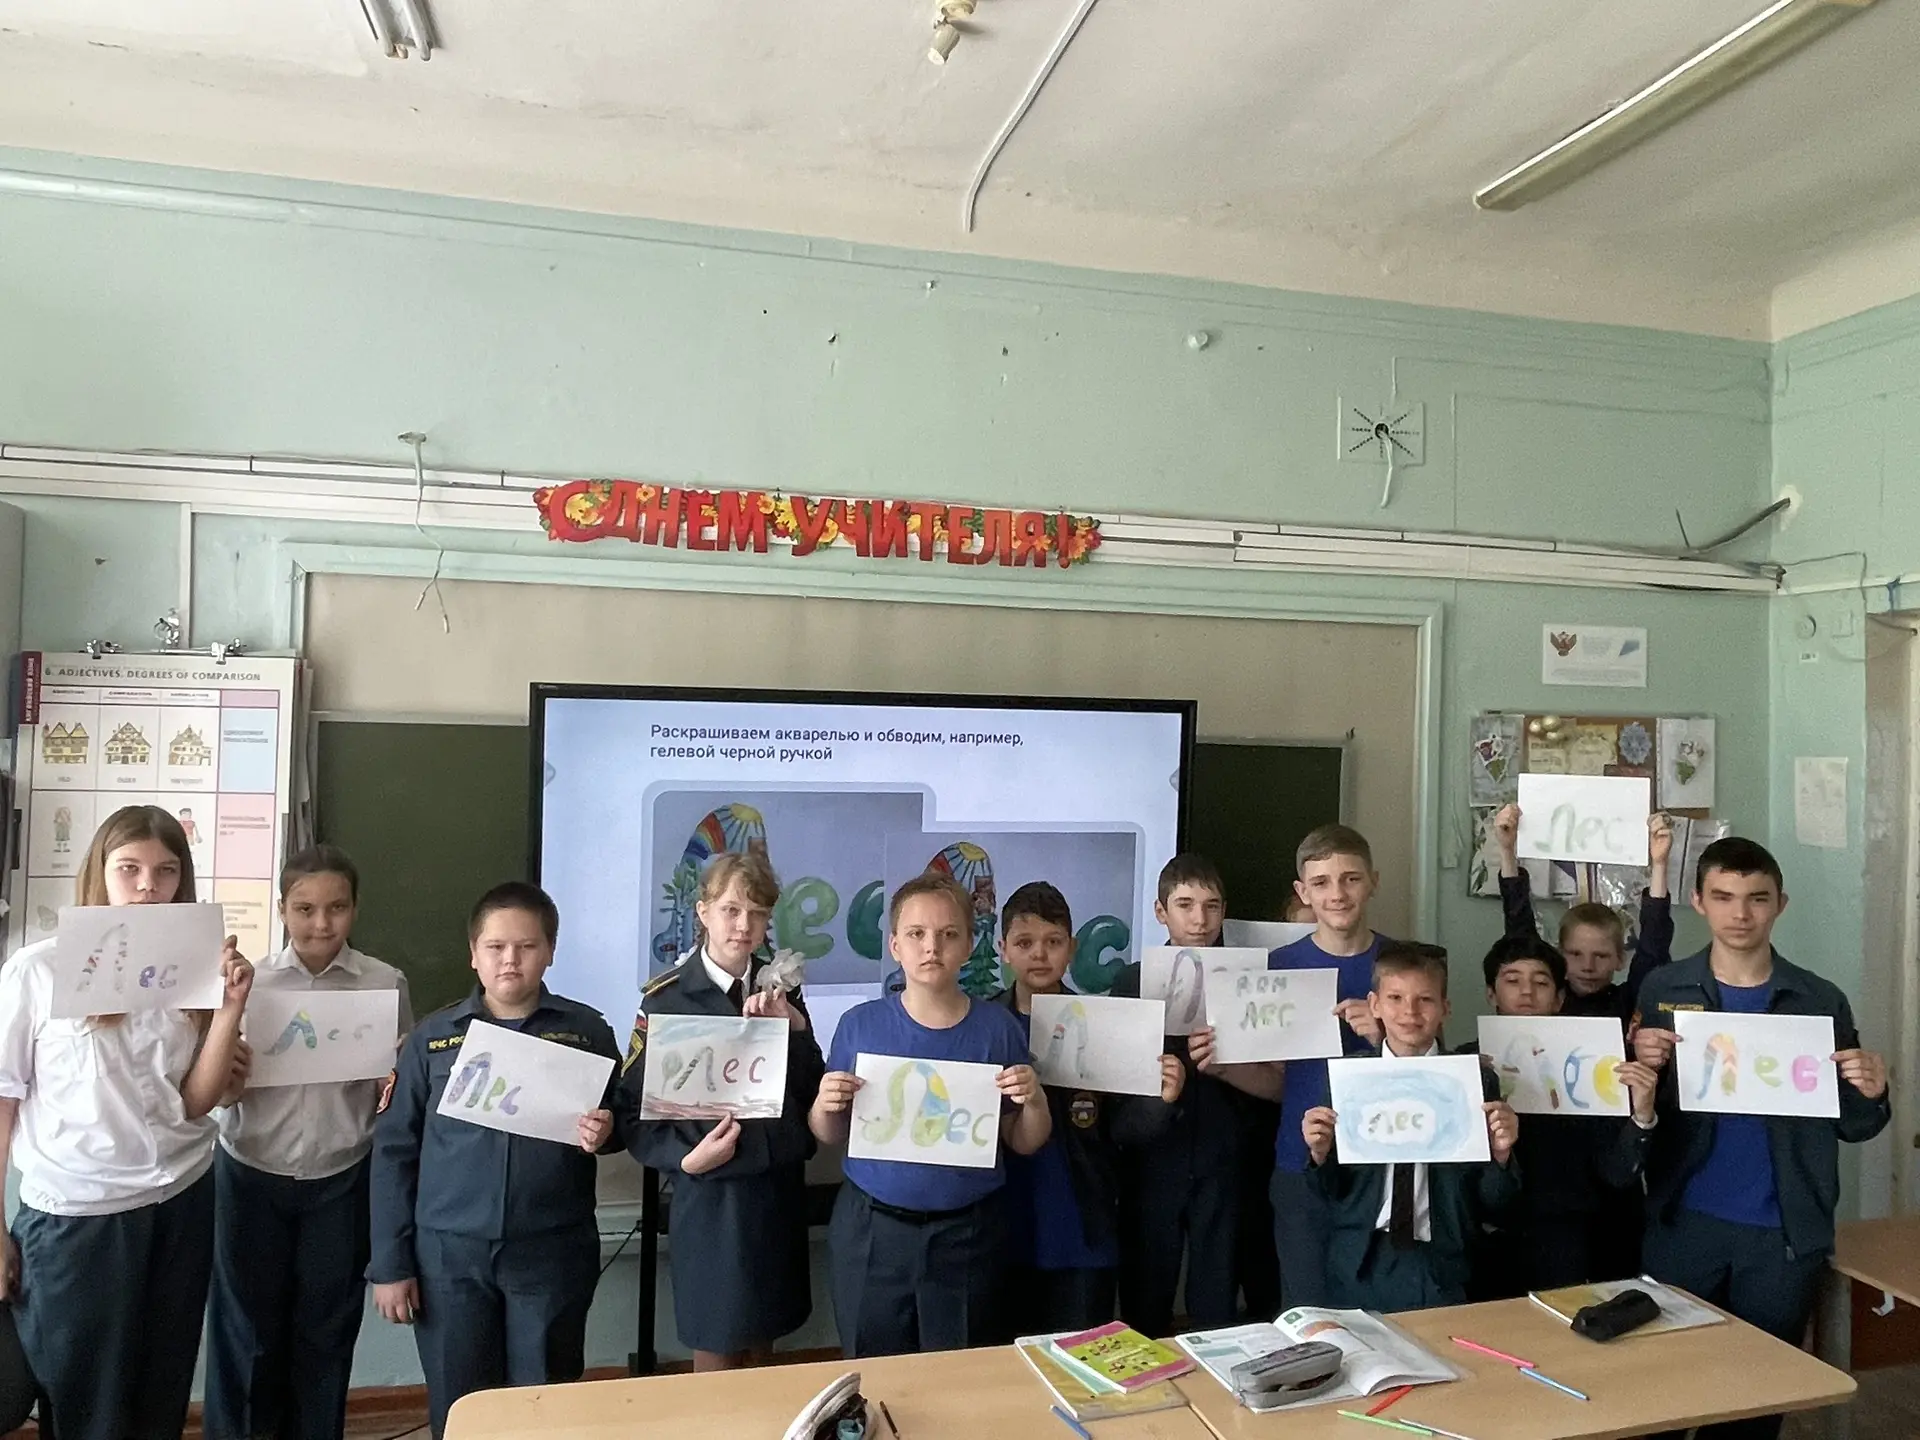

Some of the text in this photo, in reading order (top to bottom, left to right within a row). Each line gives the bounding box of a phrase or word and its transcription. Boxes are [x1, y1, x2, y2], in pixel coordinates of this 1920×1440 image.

[552, 480, 606, 543] С
[790, 496, 1070, 569] УЧИТЕЛЯ!
[127, 670, 173, 679] DEGREES
[176, 671, 189, 679] OF
[192, 672, 261, 681] COMPARISON
[650, 724, 1024, 747] Раскрашиваем акварелью и обводим, например,
[650, 744, 833, 764] гелевой черной ручкой
[76, 922, 179, 995] Лес
[446, 1051, 522, 1117] Лес
[1696, 1031, 1822, 1101] Лес
[858, 1060, 996, 1149] Лес
